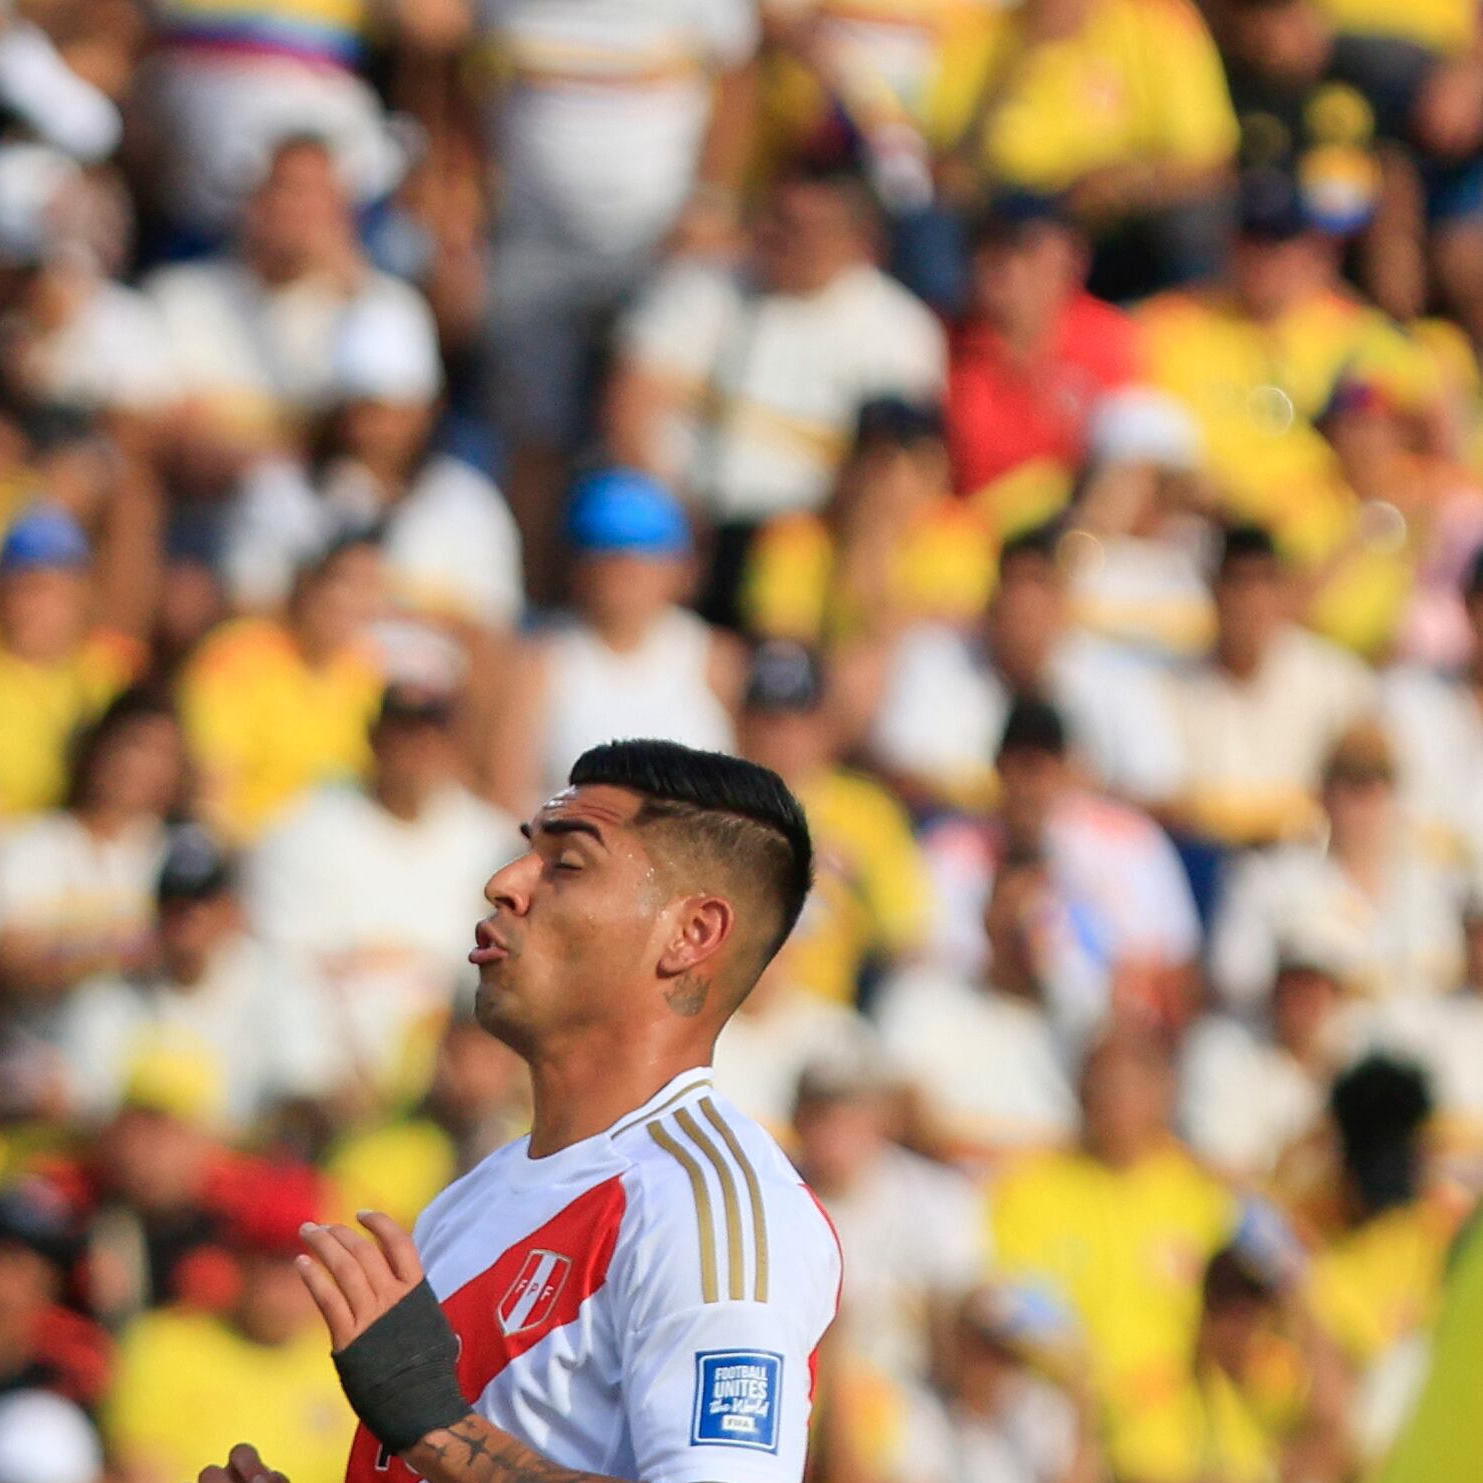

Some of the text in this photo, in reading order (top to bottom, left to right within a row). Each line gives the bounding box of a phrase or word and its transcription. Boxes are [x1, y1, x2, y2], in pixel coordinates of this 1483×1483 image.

[715, 1365, 768, 1380] FOOTBALL
[714, 1379, 768, 1399] UNITES
[731, 1397, 770, 1417] World
[726, 1417, 750, 1429] FIFA
